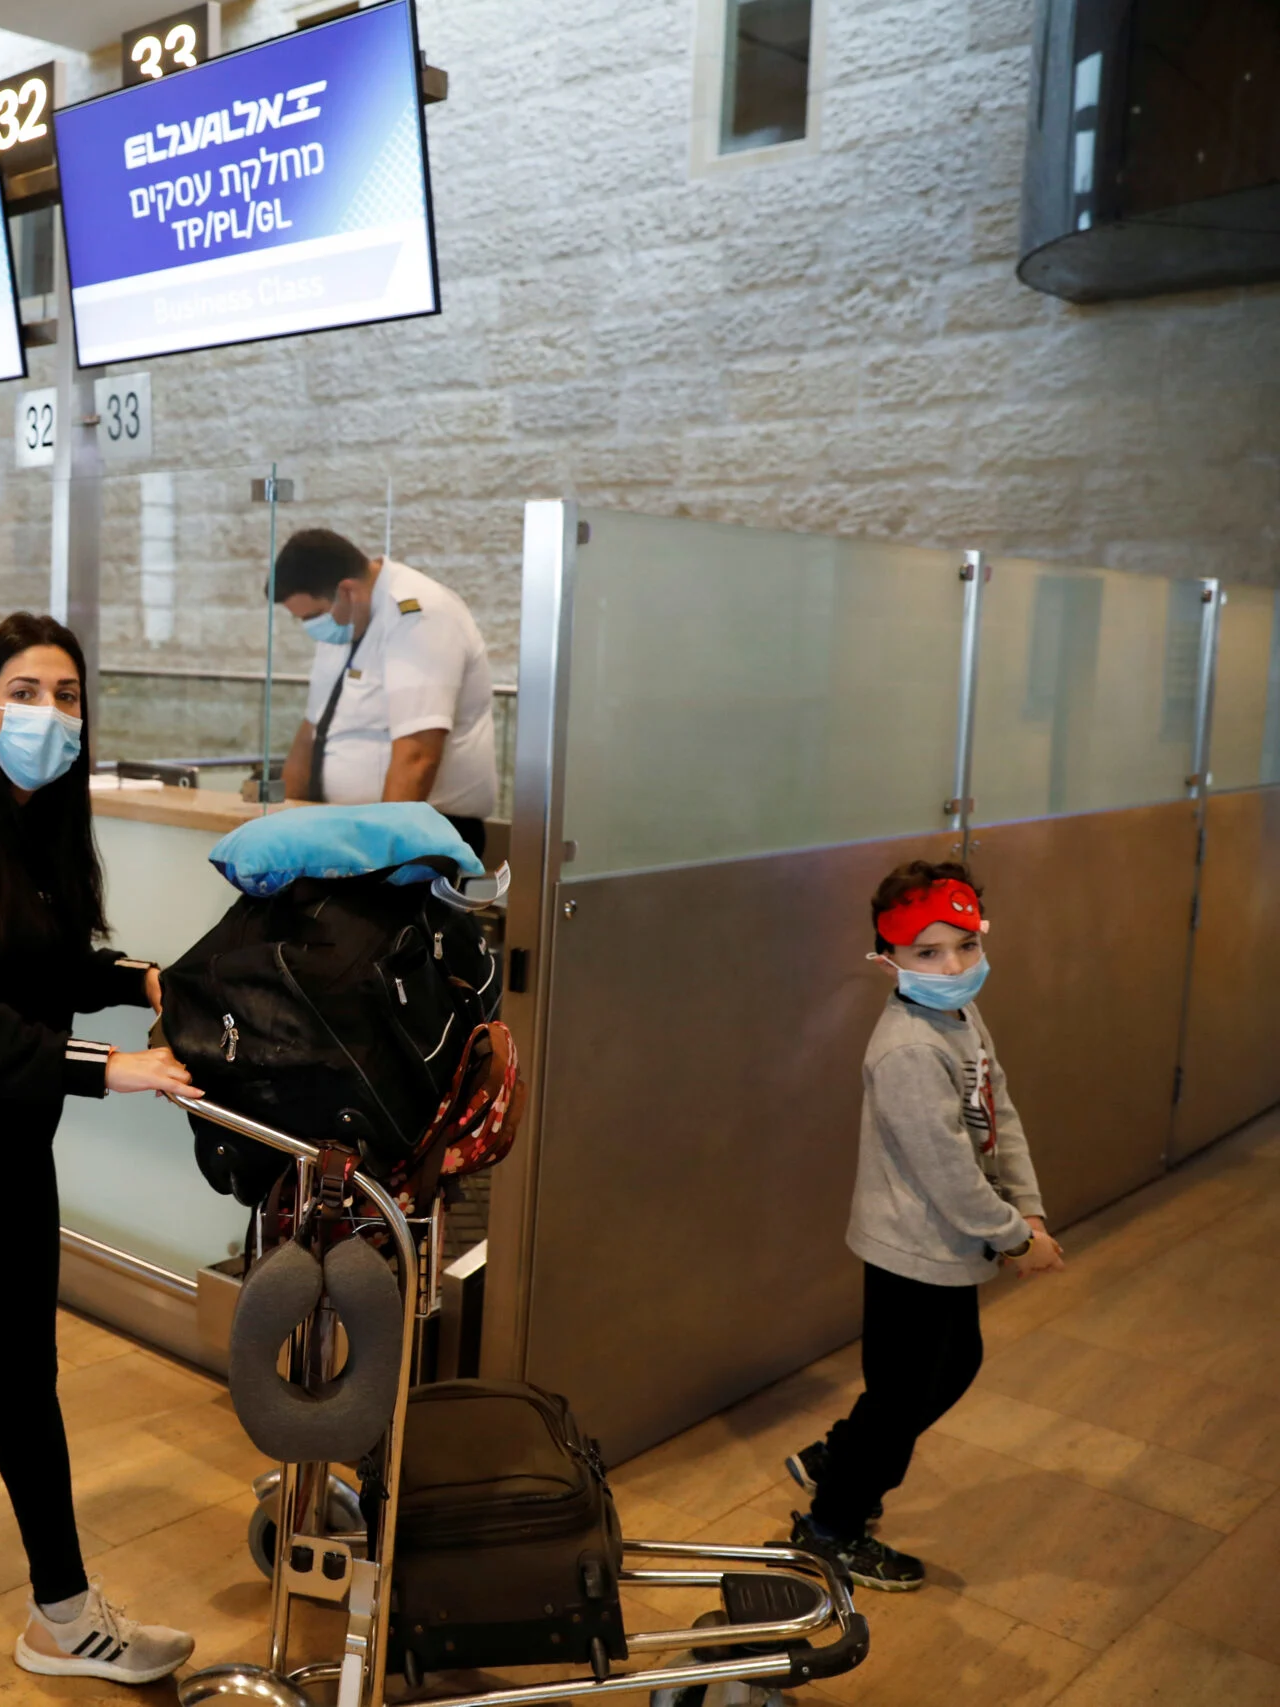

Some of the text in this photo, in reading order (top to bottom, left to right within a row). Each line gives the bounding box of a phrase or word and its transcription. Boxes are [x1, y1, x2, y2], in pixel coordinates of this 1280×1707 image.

[129, 141, 325, 223] מחלקת עסקים
[171, 198, 292, 251] TP/PL/GL
[153, 273, 326, 325] Business Class
[26, 403, 54, 449] 32
[106, 391, 141, 441] 33
